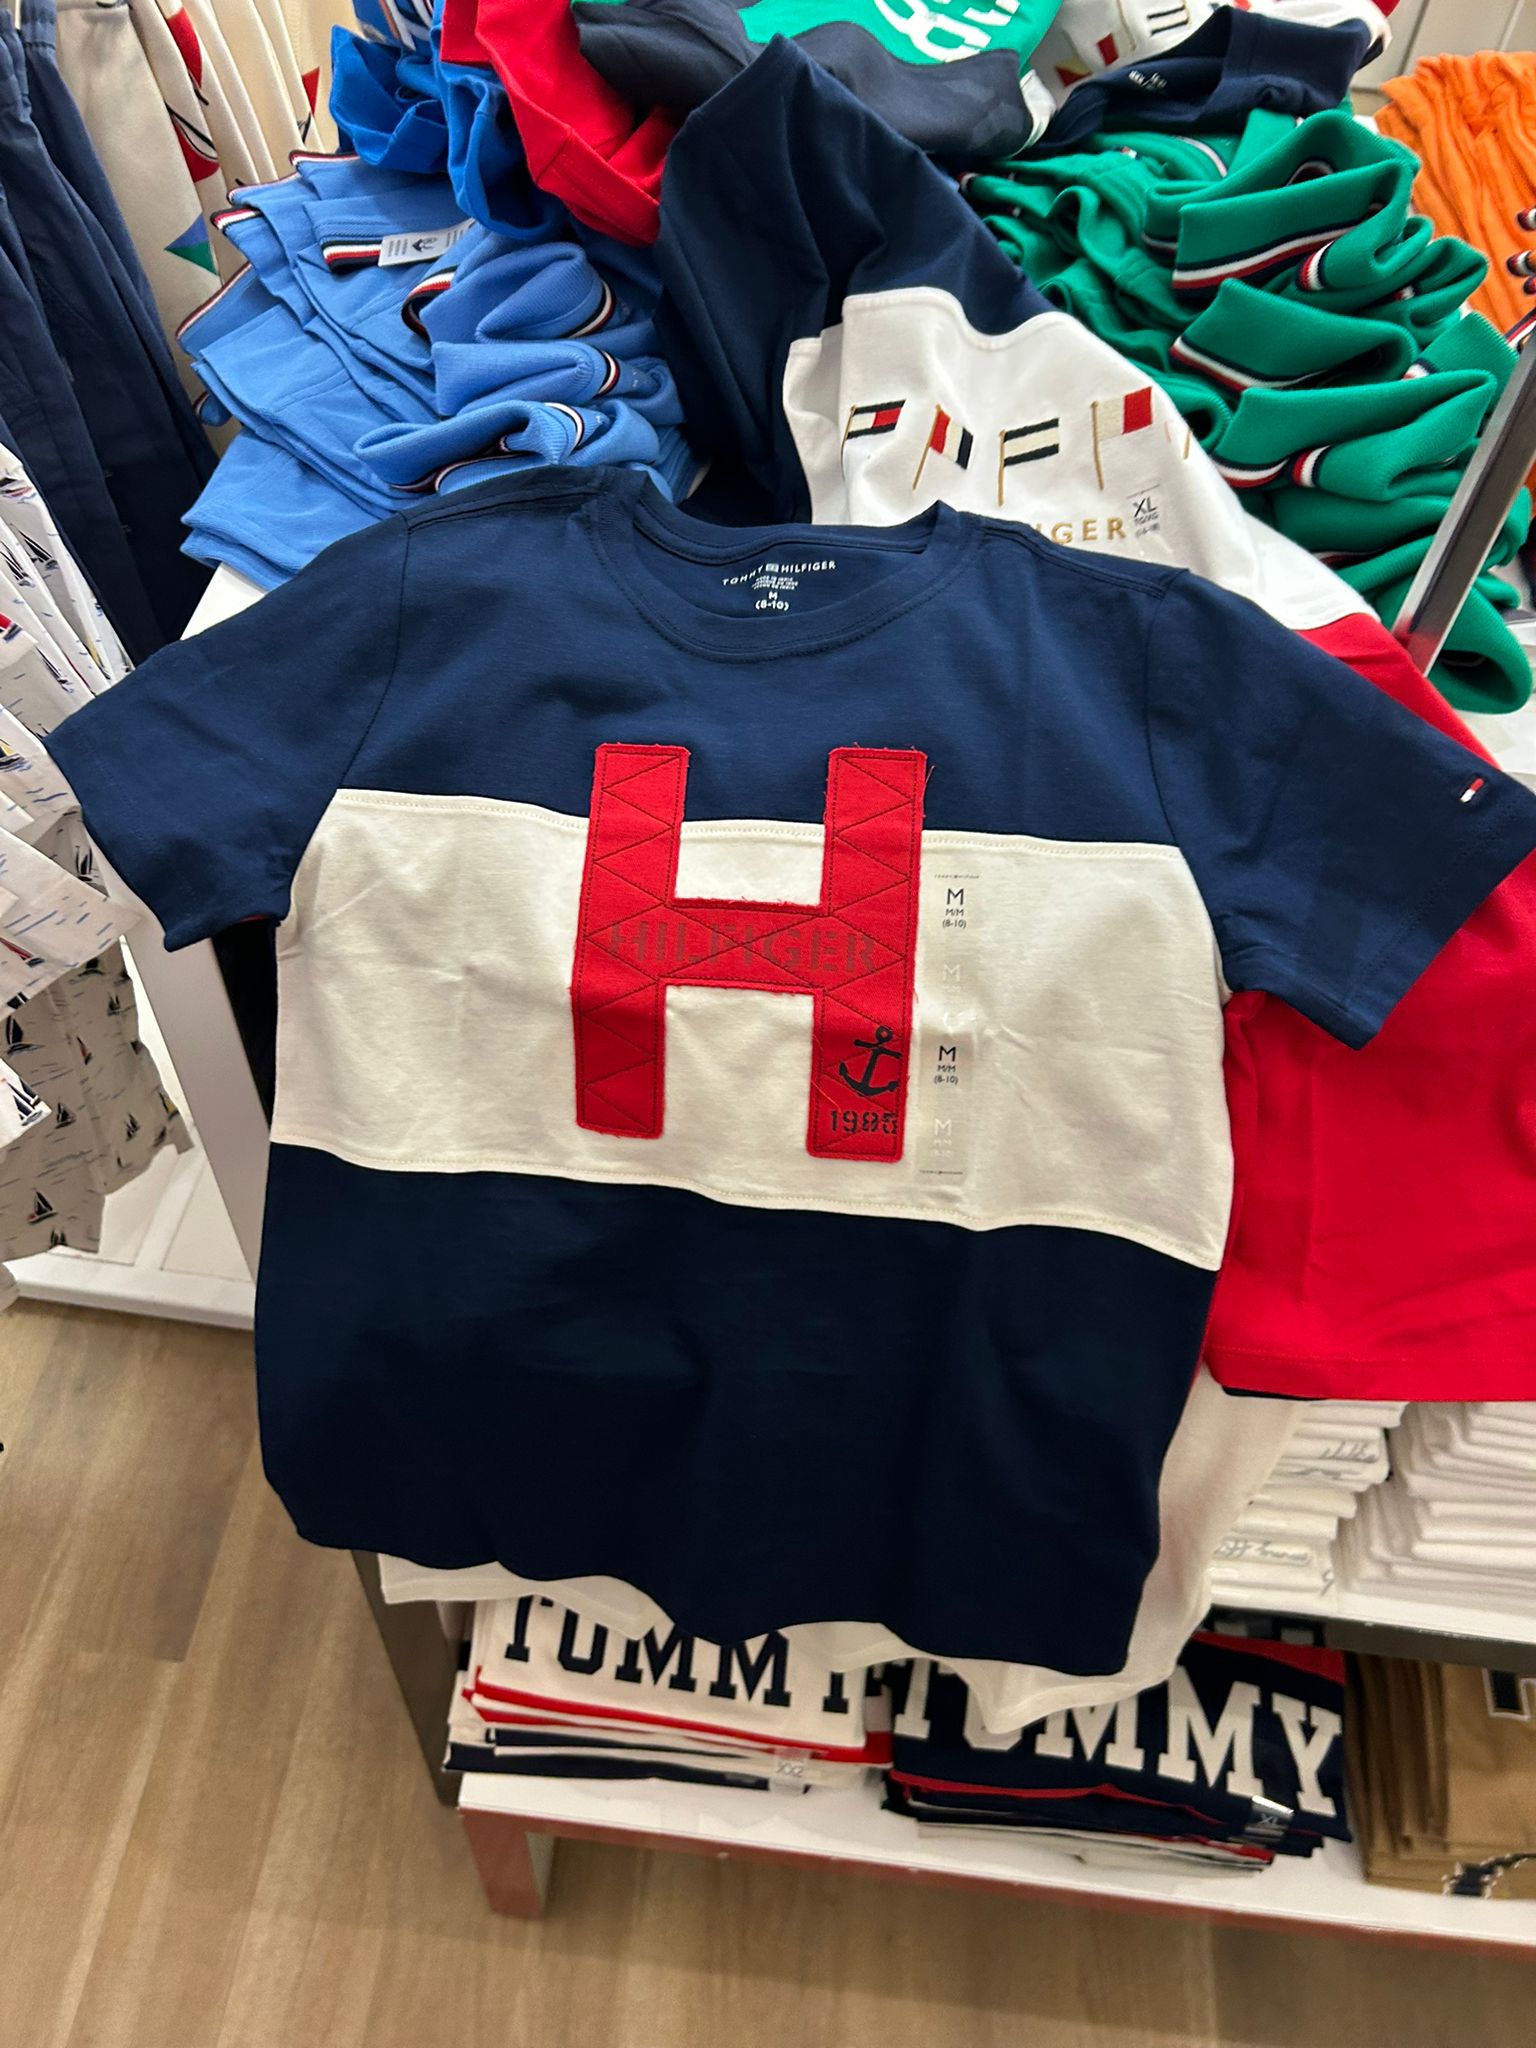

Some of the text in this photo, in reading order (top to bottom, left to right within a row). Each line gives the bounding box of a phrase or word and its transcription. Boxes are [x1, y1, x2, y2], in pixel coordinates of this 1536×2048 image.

[1132, 496, 1159, 518] XL
[722, 565, 764, 586] TOMMY
[781, 560, 836, 573] HILFIGER
[768, 591, 778, 600] M
[946, 888, 964, 905] M
[942, 919, 967, 929] (8-10)
[571, 743, 927, 1164] H
[610, 920, 877, 974] HILFIGER
[938, 1045, 957, 1062] M
